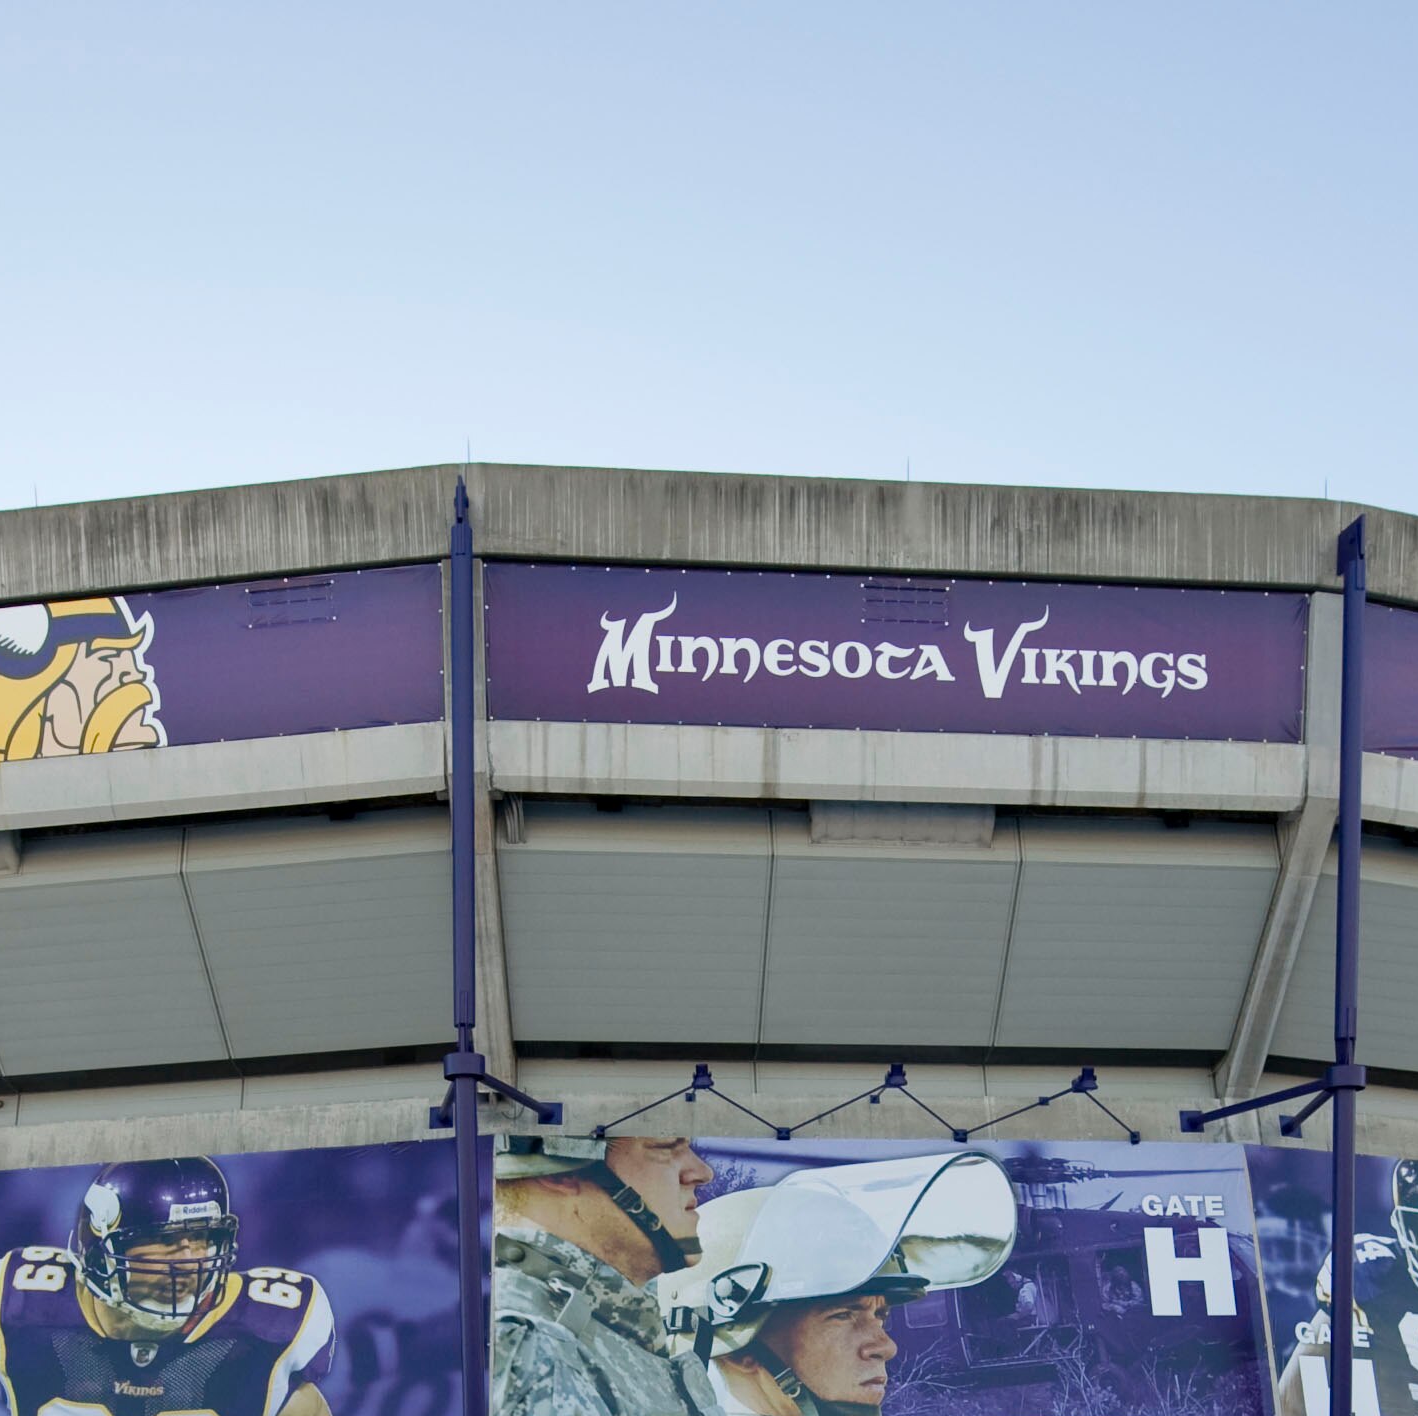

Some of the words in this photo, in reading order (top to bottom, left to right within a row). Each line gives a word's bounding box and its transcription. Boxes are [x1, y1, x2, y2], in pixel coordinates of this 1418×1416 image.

[1141, 1194, 1225, 1216] GATE
[1144, 1227, 1237, 1316] H
[1294, 1320, 1370, 1349] GAE
